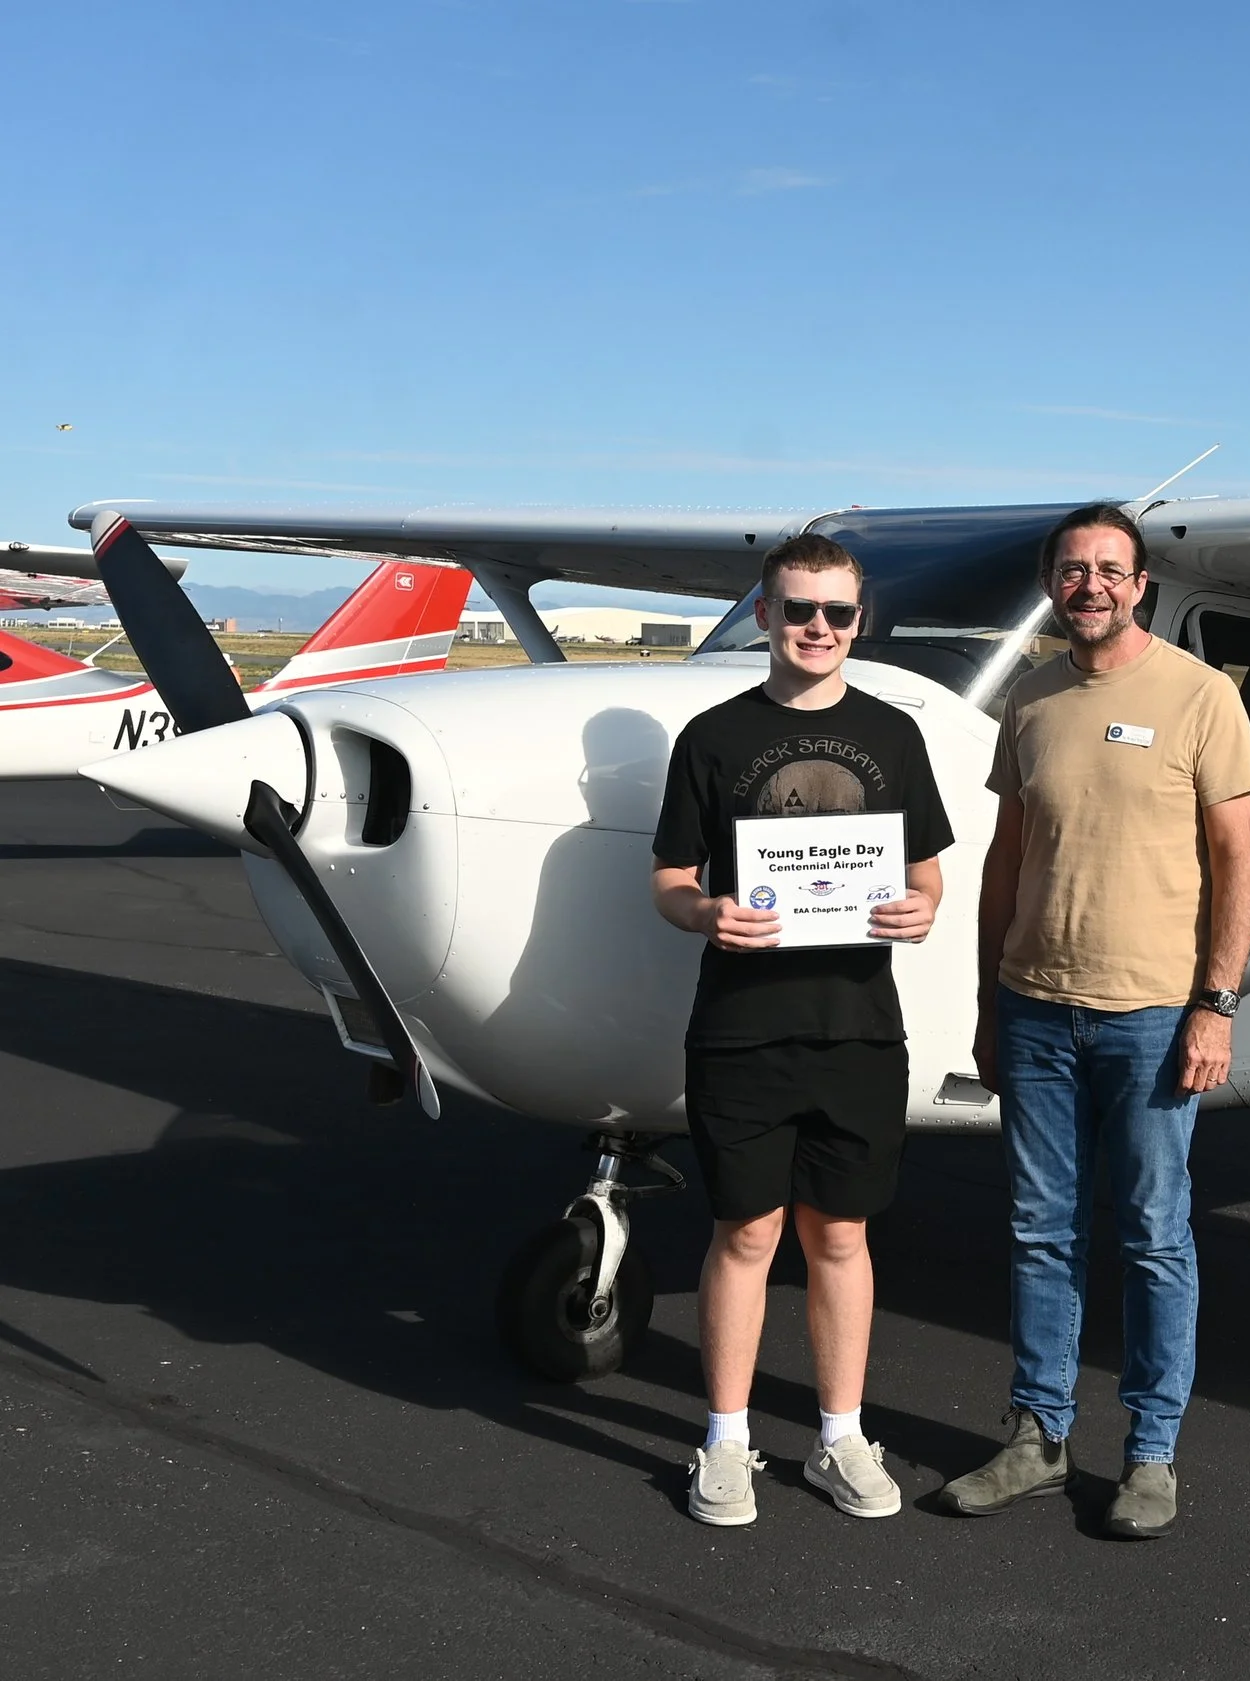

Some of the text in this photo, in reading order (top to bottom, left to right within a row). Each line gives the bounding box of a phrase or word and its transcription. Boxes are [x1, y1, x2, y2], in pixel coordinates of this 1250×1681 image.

[733, 738, 886, 797] BLACK SABBATH
[757, 844, 884, 860] Young Eagle Day
[769, 860, 874, 872] Centennial Airport
[866, 892, 890, 900] EAA
[812, 906, 842, 914] Chapter
